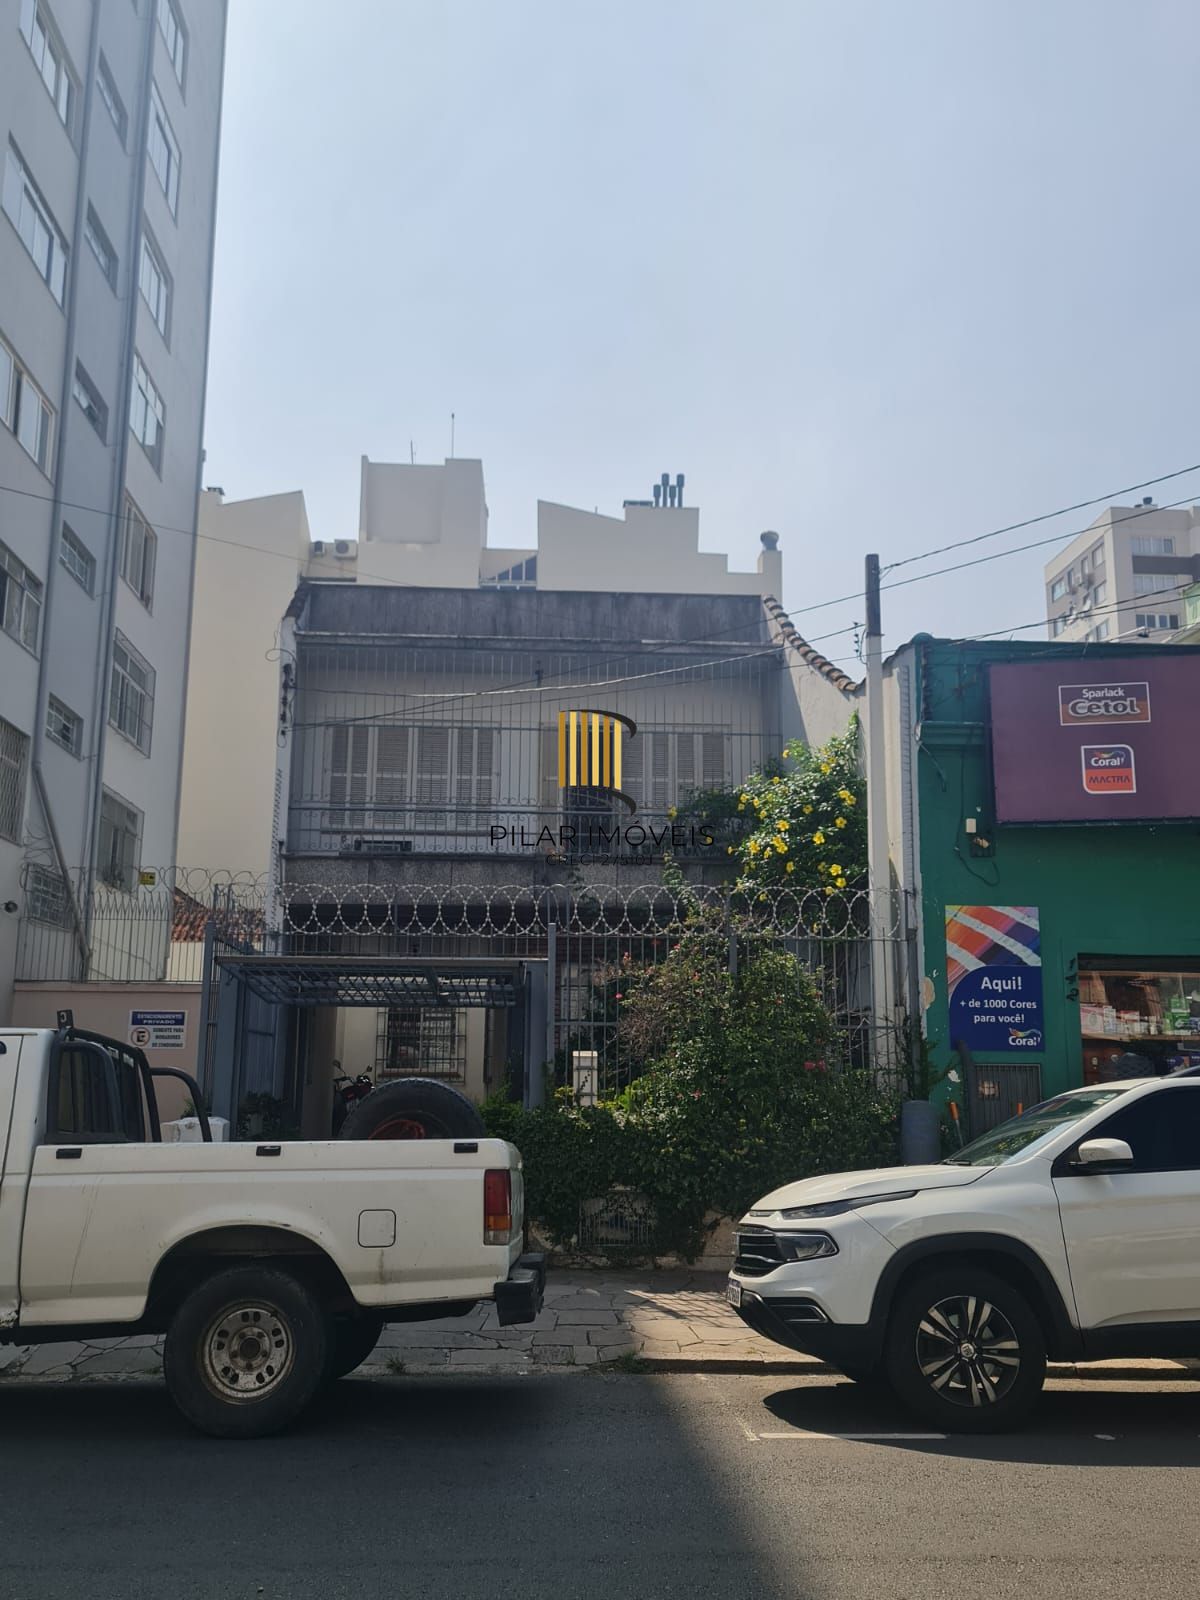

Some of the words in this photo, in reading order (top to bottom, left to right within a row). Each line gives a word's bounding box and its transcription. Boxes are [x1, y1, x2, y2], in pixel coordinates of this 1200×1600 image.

[1082, 687, 1125, 699] Sparlack
[1069, 697, 1140, 717] Cetol
[1090, 757, 1121, 767] Coral
[1088, 775, 1130, 784] MACTRA
[980, 976, 1023, 993] Aqui!
[959, 1000, 967, 1008] +
[968, 998, 981, 1008] de
[984, 999, 1007, 1009] 1000
[1009, 999, 1037, 1009] Cores
[973, 1014, 996, 1024] para
[998, 1013, 1025, 1023] você!
